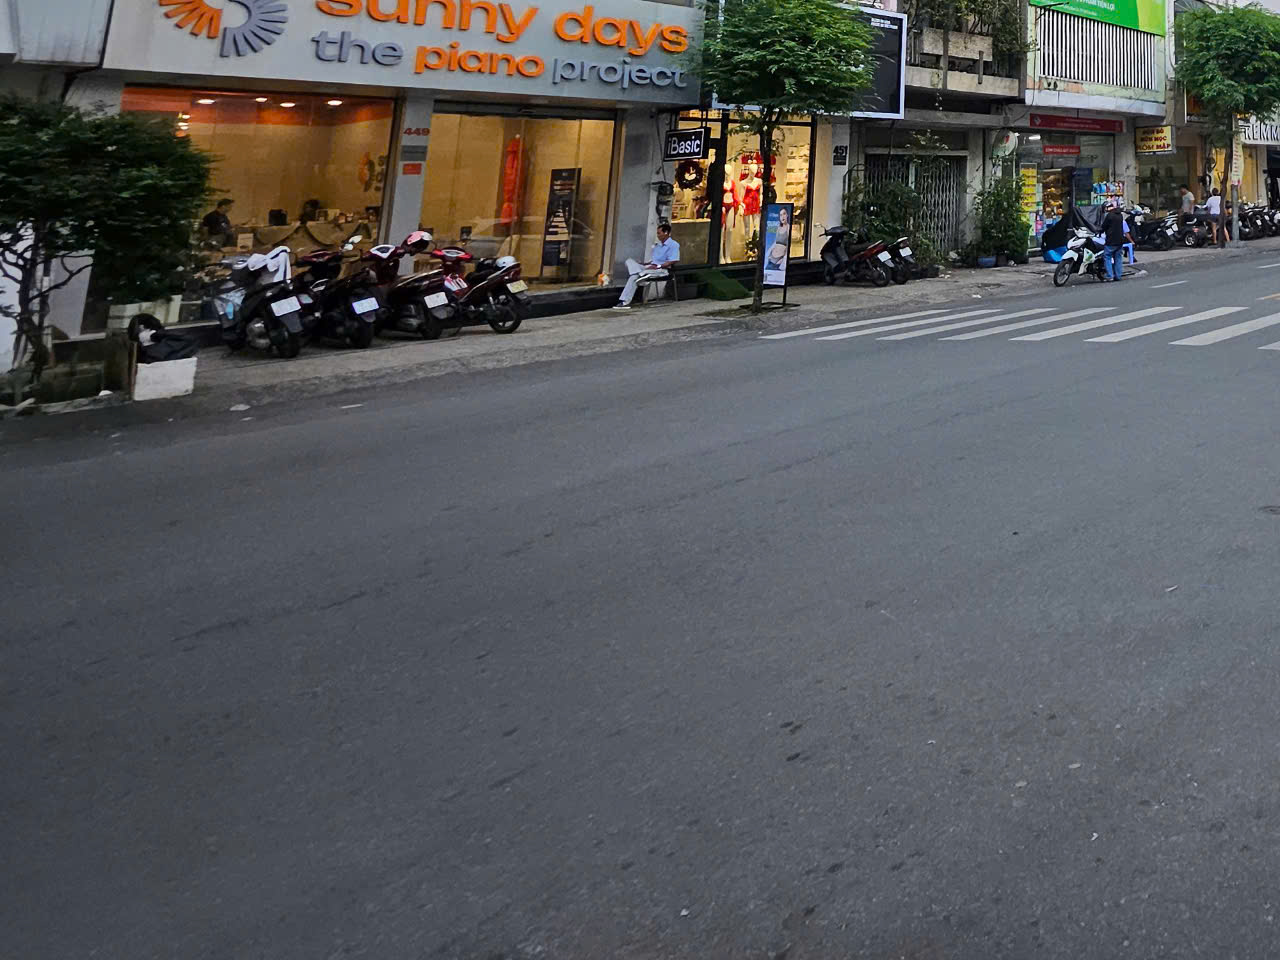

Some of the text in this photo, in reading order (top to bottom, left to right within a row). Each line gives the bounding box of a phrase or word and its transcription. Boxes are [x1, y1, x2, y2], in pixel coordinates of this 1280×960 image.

[554, 5, 689, 56] days
[312, 30, 689, 89] the piano project
[667, 136, 701, 155] iBasic
[833, 145, 848, 157] 451
